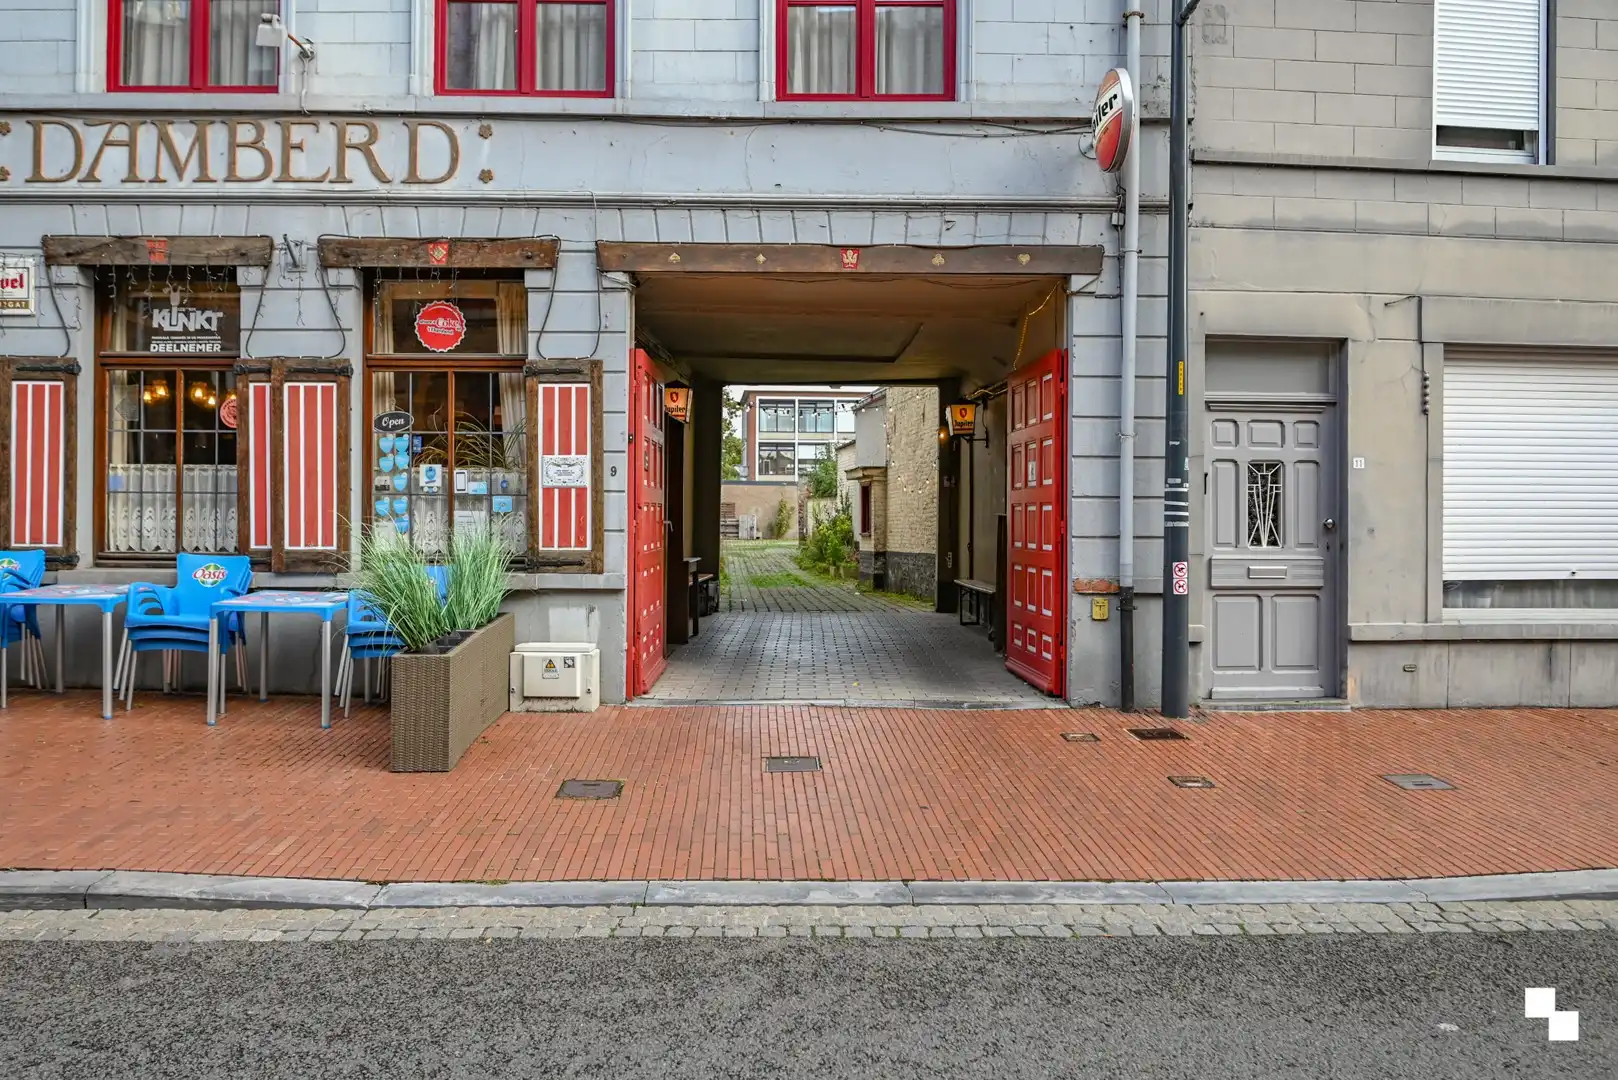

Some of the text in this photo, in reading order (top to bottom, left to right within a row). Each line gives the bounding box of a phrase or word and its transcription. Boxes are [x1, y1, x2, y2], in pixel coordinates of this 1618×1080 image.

[24, 119, 461, 184] DAMBERD
[150, 343, 221, 352] DEELNEMER
[382, 417, 405, 429] Open
[610, 466, 617, 477] 9
[193, 567, 226, 580] Oasis
